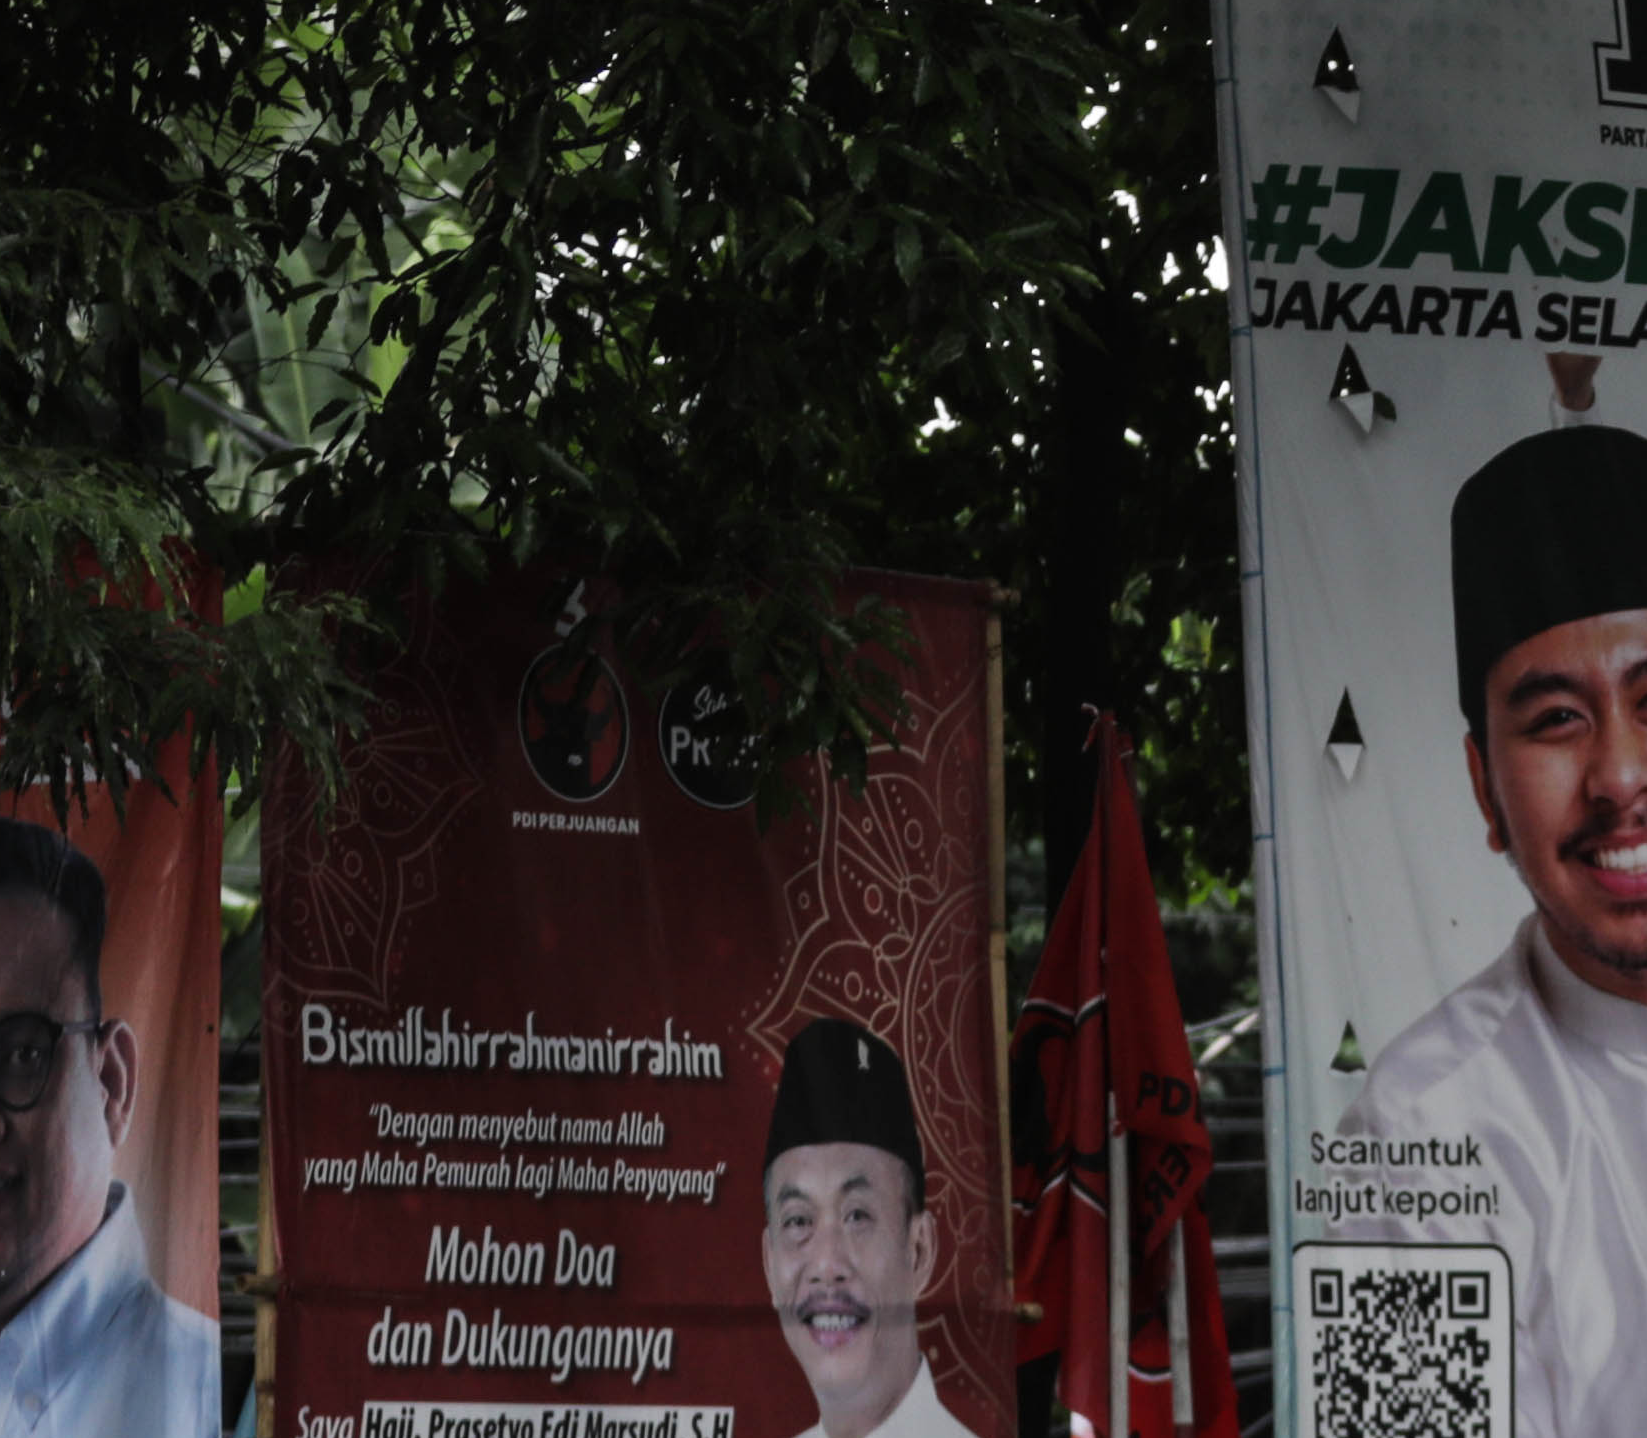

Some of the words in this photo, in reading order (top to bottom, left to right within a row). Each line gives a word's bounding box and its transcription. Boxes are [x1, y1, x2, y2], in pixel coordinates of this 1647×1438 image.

[1249, 277, 1523, 343] JAKARTA
[512, 811, 538, 830] PDI
[540, 812, 640, 836] PERJUANGAN
[458, 1111, 557, 1151] menyebut
[560, 1117, 613, 1146] nama
[616, 1111, 665, 1147] Allah
[1310, 1133, 1383, 1168] Scan
[1385, 1133, 1483, 1168] untuk
[303, 1157, 356, 1195] yang
[360, 1151, 418, 1188] Maha
[421, 1153, 511, 1191] Pemurah
[515, 1156, 554, 1199] lagi
[557, 1161, 608, 1193] Maha
[1294, 1179, 1379, 1222] lanjut
[1381, 1183, 1500, 1221] kepoin!
[424, 1224, 545, 1286] Mohon
[553, 1228, 617, 1288] Doa
[367, 1306, 433, 1366] dan
[441, 1308, 674, 1385] Dukungannya
